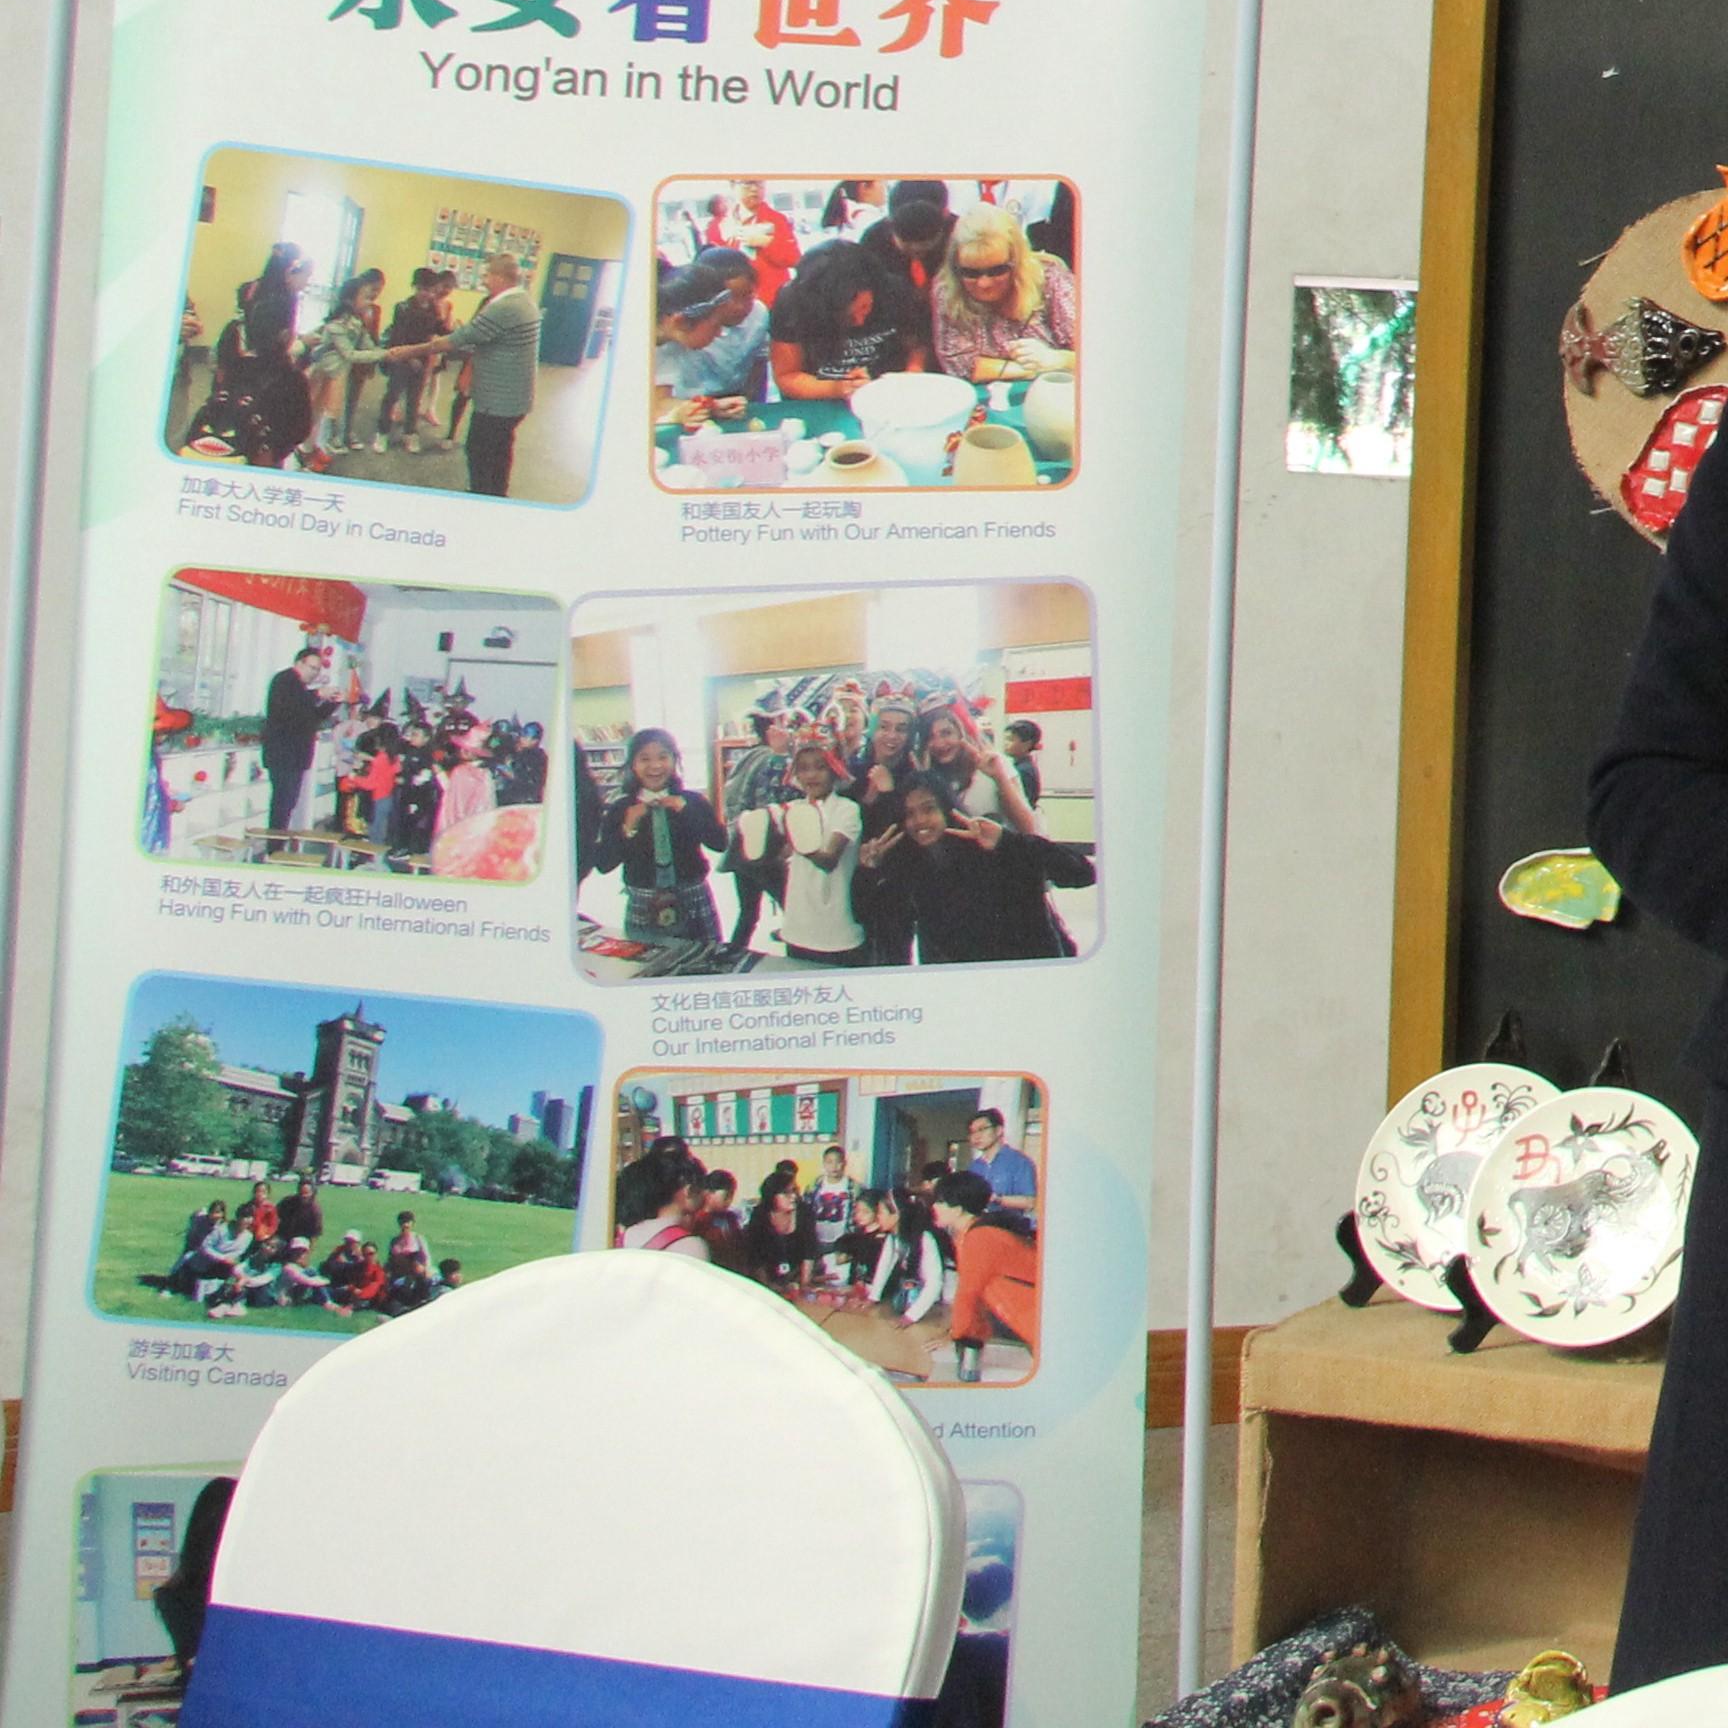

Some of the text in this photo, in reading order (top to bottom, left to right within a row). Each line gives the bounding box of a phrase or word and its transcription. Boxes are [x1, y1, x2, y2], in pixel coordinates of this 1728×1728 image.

[420, 51, 900, 112] Yong'an in the World
[181, 474, 346, 513] 加拿大入学第一天
[178, 498, 446, 547] First School Day in Canada
[681, 501, 862, 521] 和美国友人一起玩陶
[681, 520, 1056, 545] Pottery Fun with Our American Friends
[160, 874, 467, 913] 和外国友人在一起疯狂Halloween
[158, 898, 551, 943] Having Fun with Our International Friends
[652, 984, 853, 1013] 文化自信征服国外友人
[652, 1004, 923, 1034] Culture Confidence Enticing
[652, 1027, 896, 1057] Our International Friends
[128, 1338, 235, 1362] 游学加拿大
[128, 1363, 288, 1387] Visiting Canada
[950, 1422, 1036, 1439] Attention
